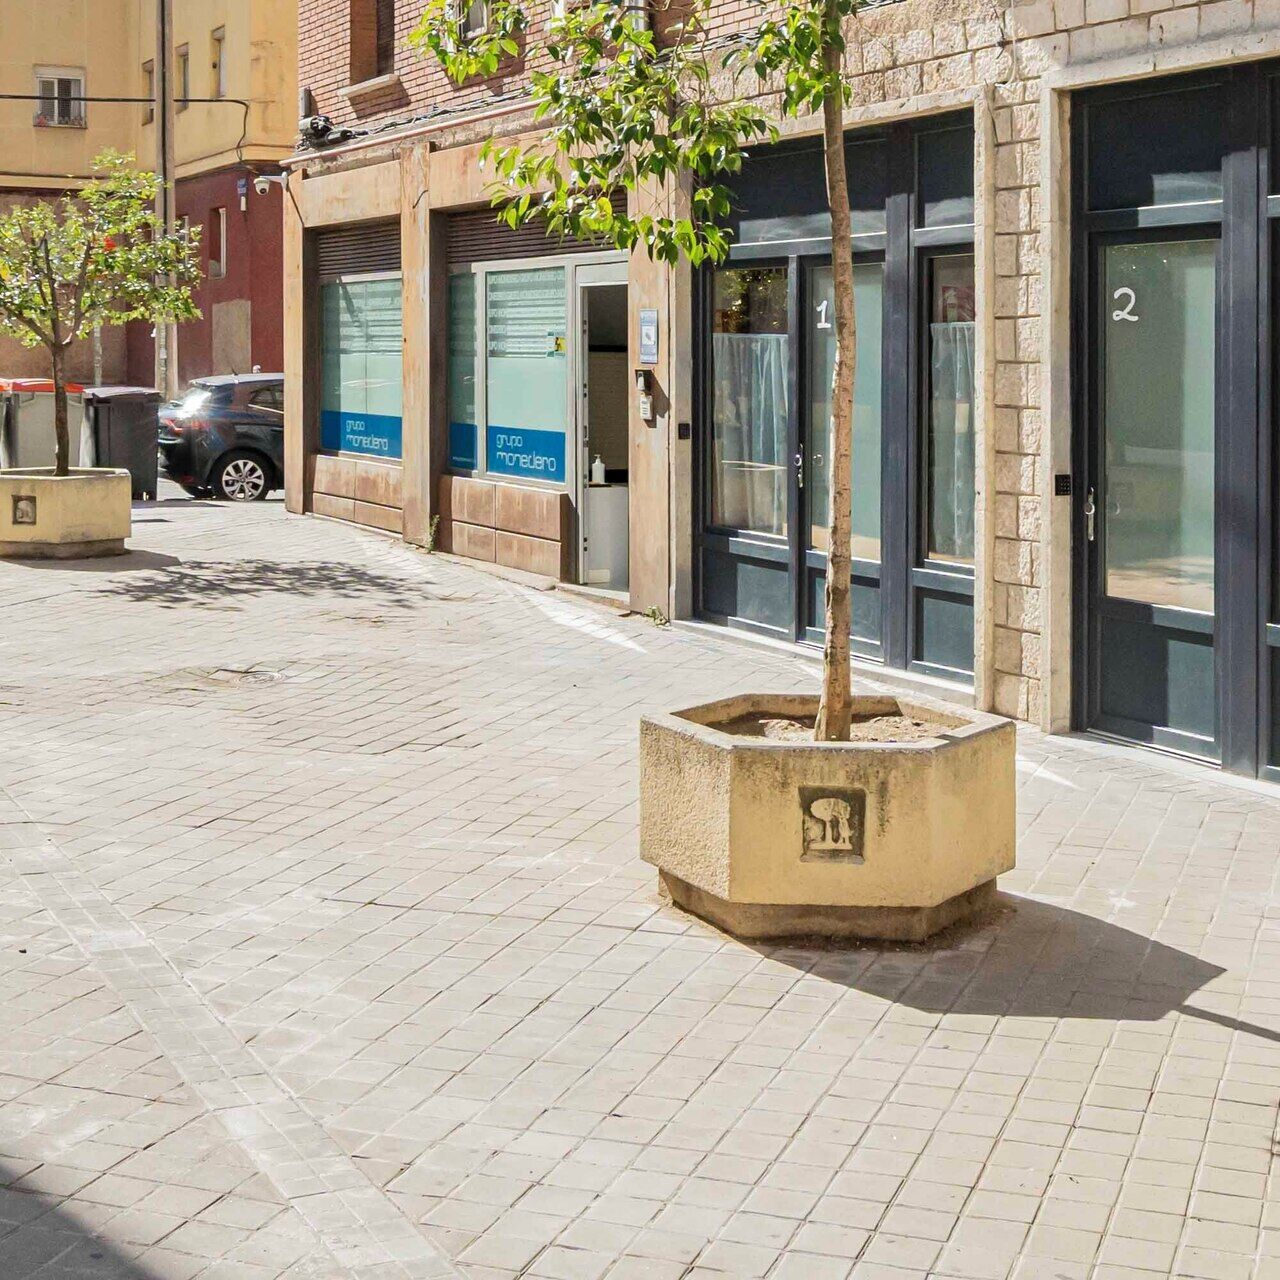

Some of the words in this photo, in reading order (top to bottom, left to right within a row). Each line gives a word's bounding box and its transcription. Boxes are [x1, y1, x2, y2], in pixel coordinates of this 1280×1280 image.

[1112, 287, 1139, 321] 2
[816, 300, 831, 328] 1
[345, 420, 365, 432] grupo
[345, 434, 389, 451] monedero
[496, 434, 523, 449] grupo
[496, 450, 557, 472] monedero
